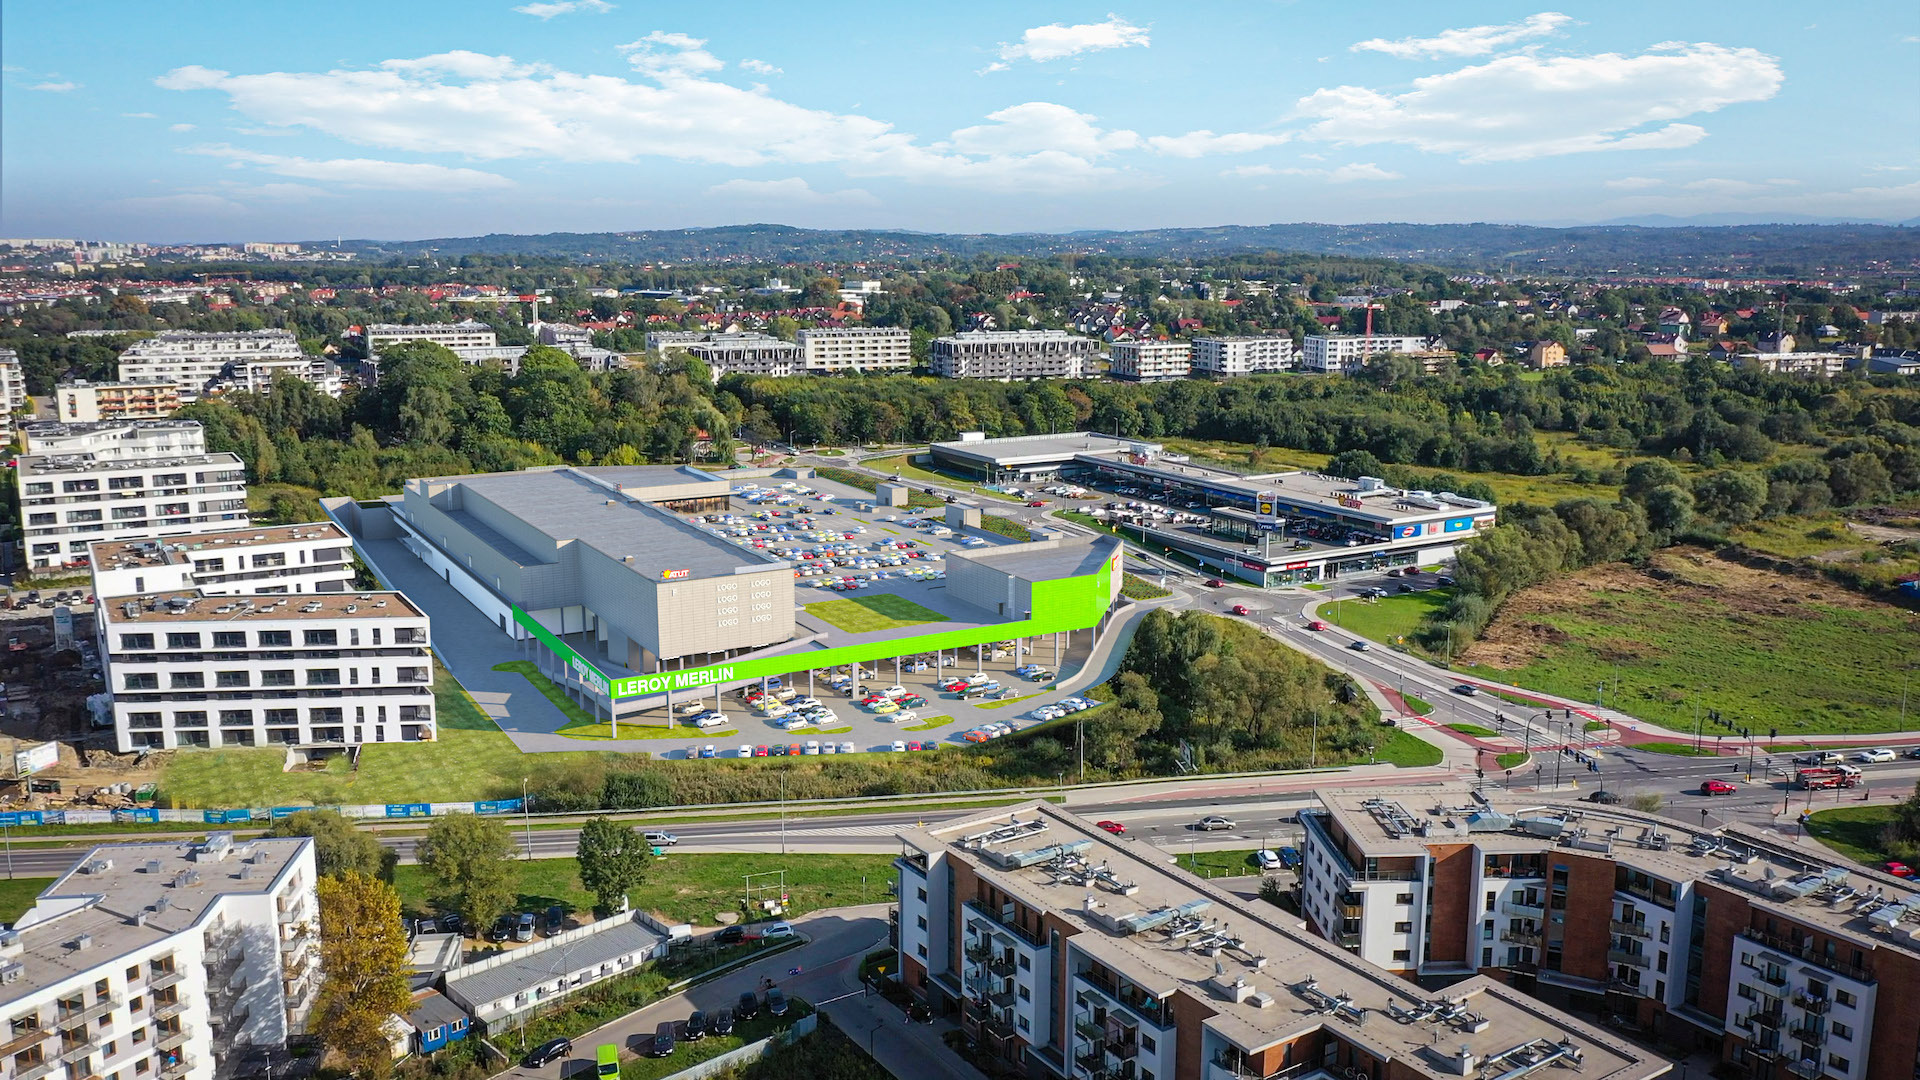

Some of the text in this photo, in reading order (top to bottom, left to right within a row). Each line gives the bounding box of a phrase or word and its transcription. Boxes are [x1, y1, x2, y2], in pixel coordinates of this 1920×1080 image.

[669, 569, 690, 579] ATUT
[717, 583, 738, 591] LOGO
[751, 579, 771, 587] LOGO
[717, 595, 738, 603] LOGO
[751, 591, 772, 599] LOGO
[718, 606, 739, 615] LOGO
[752, 602, 772, 611] LOGO
[718, 618, 739, 627] LOGO
[752, 614, 772, 623] LOGO
[618, 667, 734, 696] LEROY MERLIN
